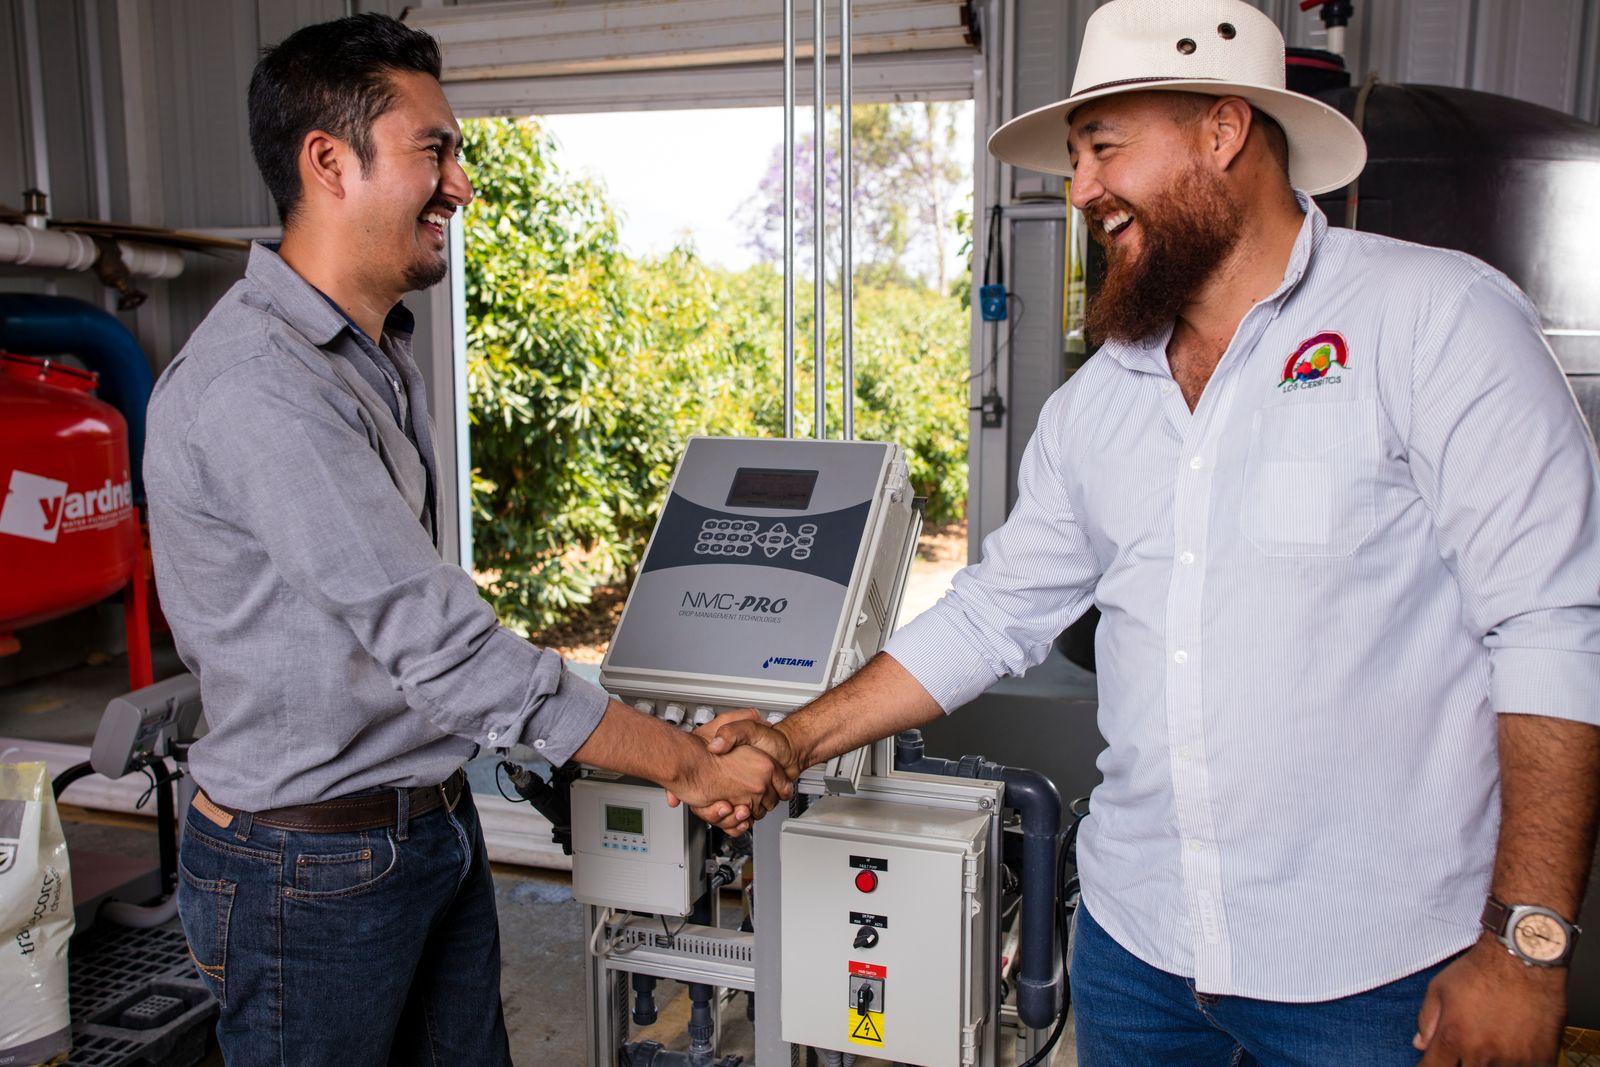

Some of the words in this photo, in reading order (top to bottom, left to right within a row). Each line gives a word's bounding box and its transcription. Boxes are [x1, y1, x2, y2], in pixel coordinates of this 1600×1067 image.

[1282, 383, 1298, 393] LOS
[38, 479, 133, 531] yardne
[681, 591, 788, 614] NMC-PRO
[695, 611, 737, 621] MANAGEMENT
[738, 614, 782, 624] TECHNOLOGIES
[773, 656, 815, 668] NETAFIM
